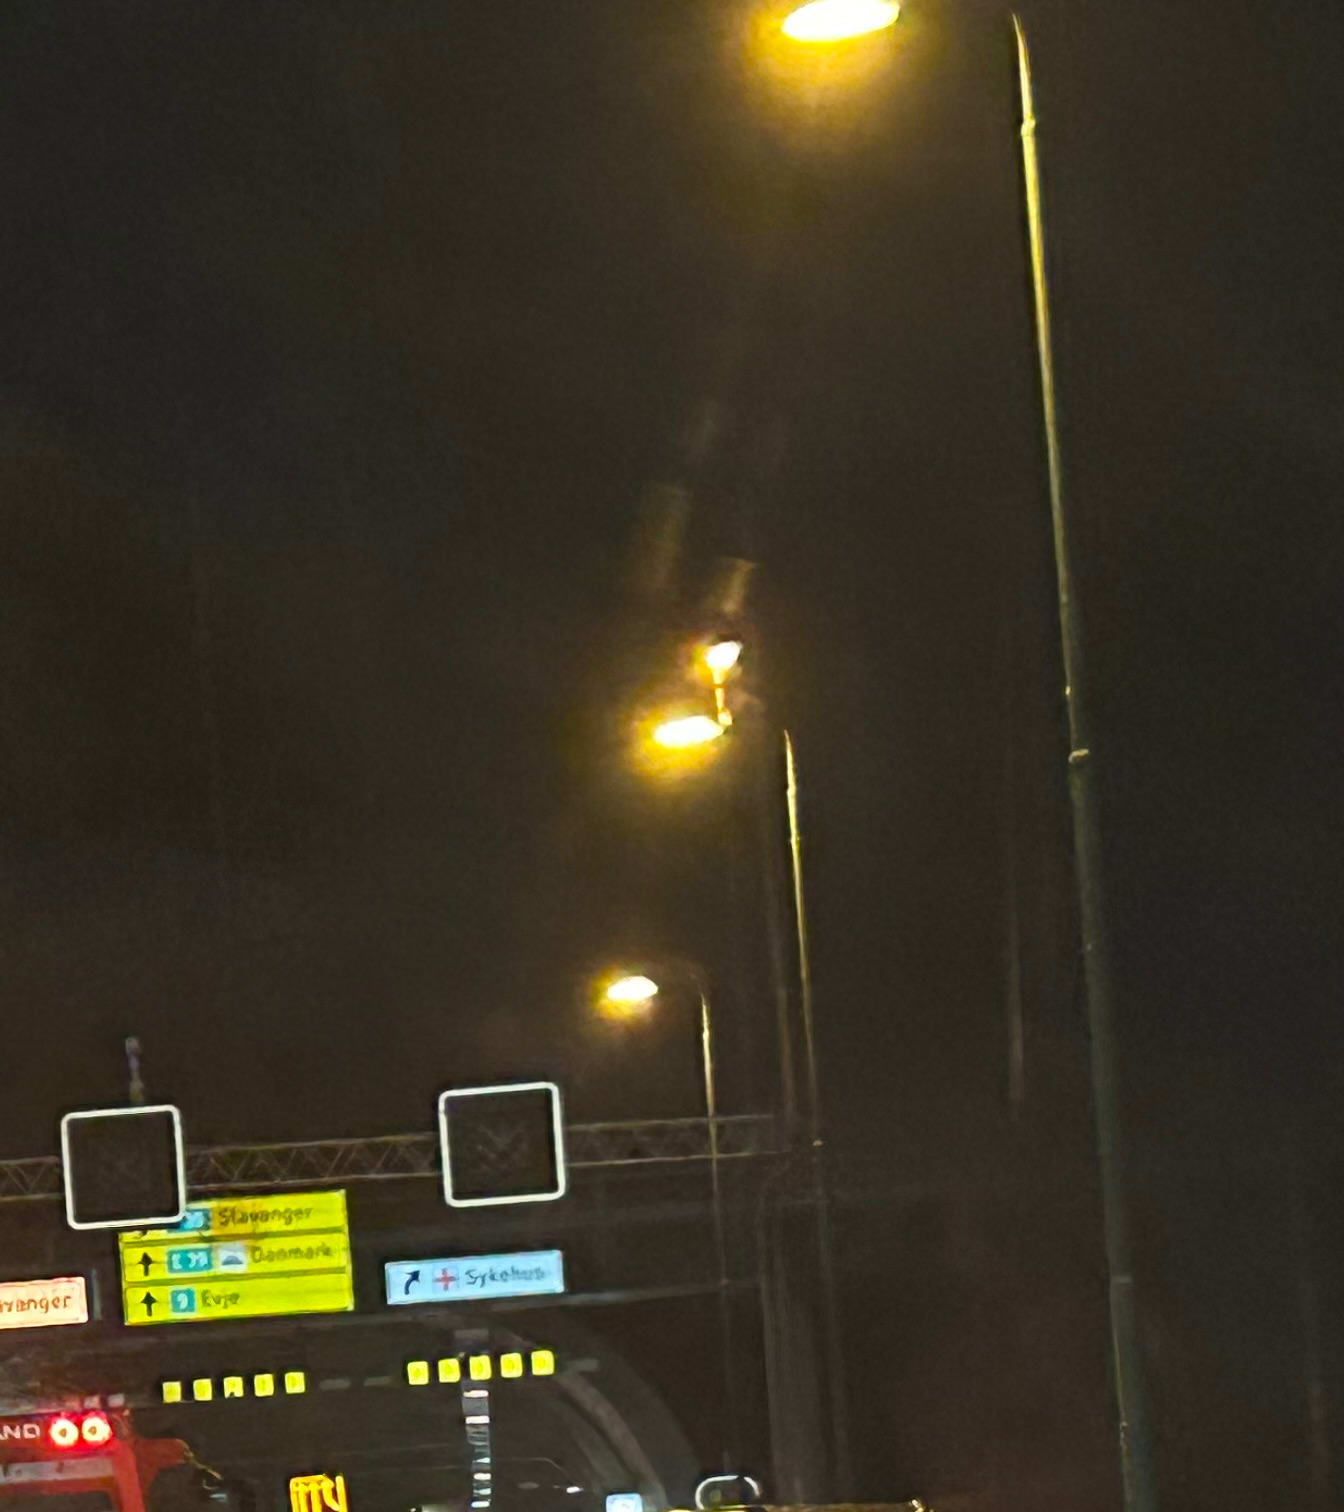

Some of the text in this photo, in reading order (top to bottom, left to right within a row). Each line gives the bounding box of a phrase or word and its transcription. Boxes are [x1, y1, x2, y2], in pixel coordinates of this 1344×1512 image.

[218, 1206, 314, 1227] Stavanger
[251, 1242, 332, 1264] Danmark
[464, 1266, 546, 1288] Sykehus
